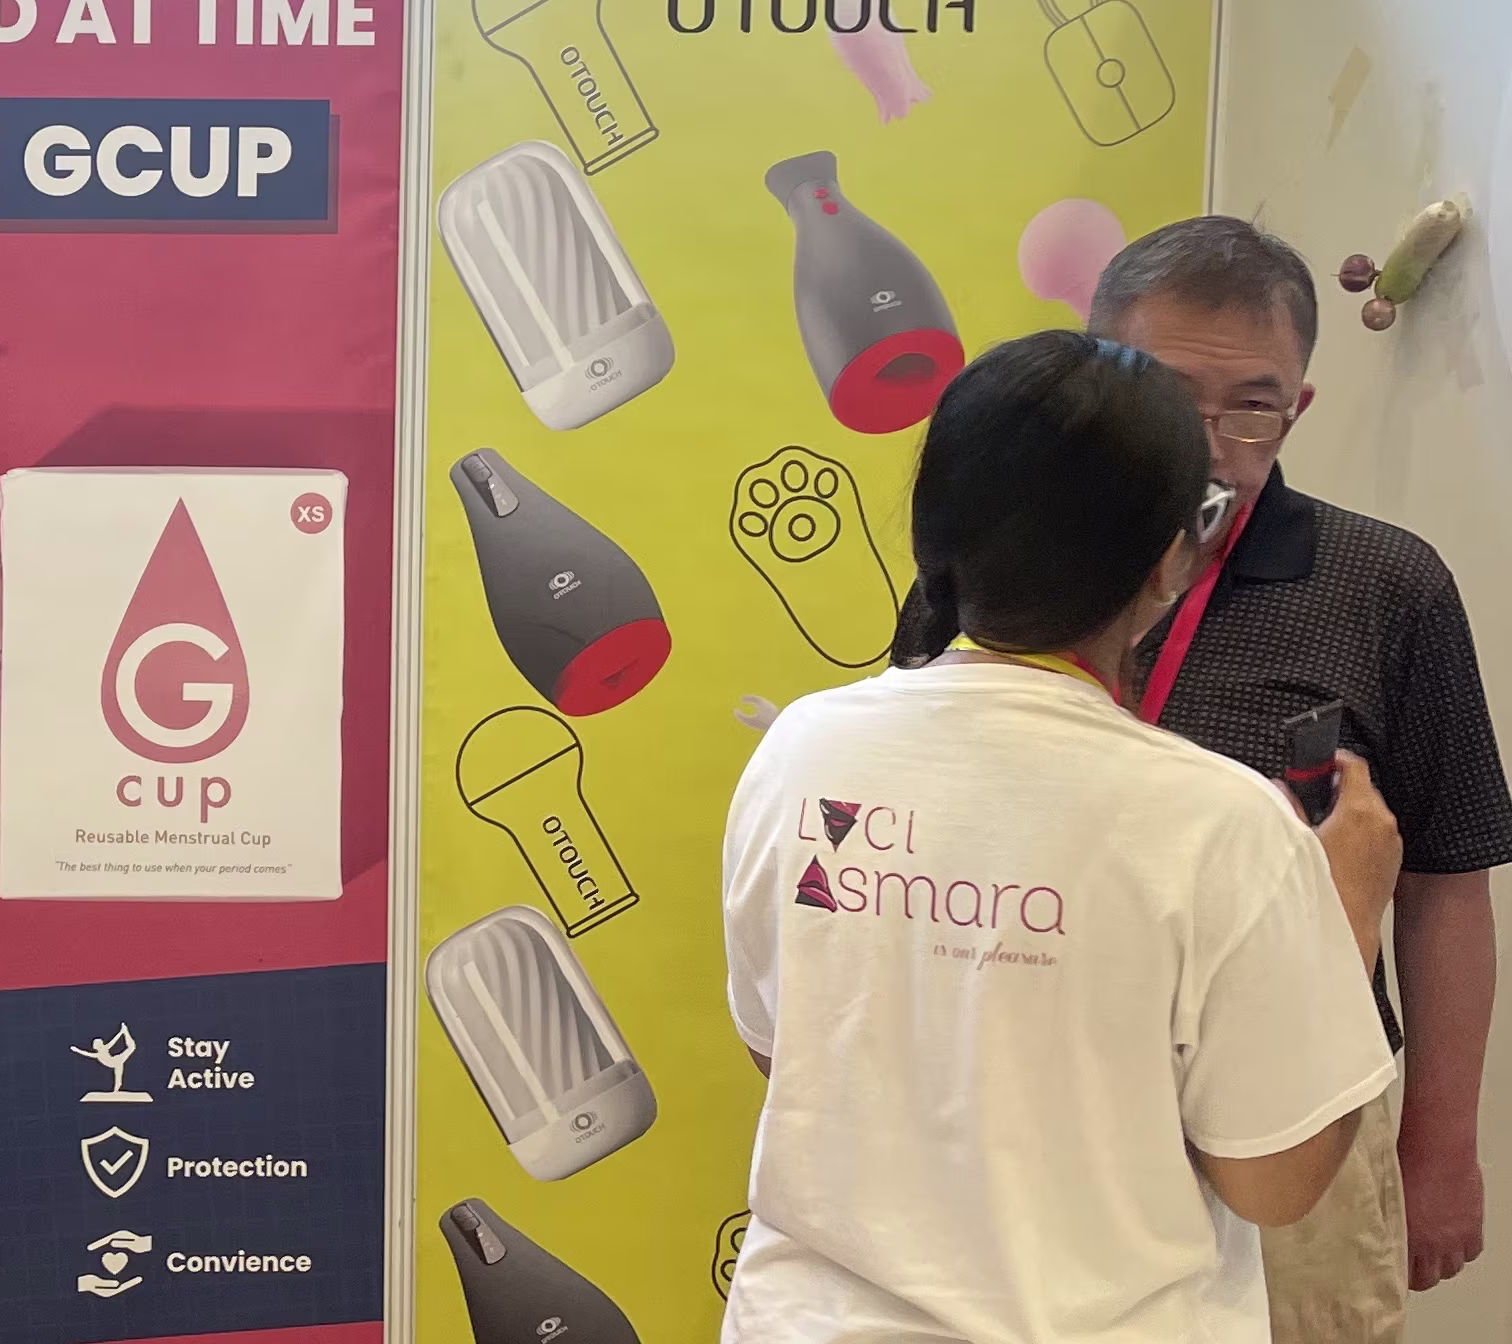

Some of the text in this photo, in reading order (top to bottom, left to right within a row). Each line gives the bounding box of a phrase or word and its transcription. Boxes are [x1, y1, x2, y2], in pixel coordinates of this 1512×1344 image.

[560, 45, 625, 146] OTOUCH
[23, 124, 292, 198] GCUP
[296, 504, 326, 524] XS
[115, 622, 235, 748] G
[116, 774, 232, 824] cup
[74, 828, 272, 849] Reusable Menstrual Cup
[79, 861, 102, 873] best
[103, 861, 130, 875] thing
[132, 862, 142, 874] to
[144, 864, 163, 873] use
[165, 862, 193, 874] when
[194, 864, 217, 876] your
[218, 862, 252, 876] period
[541, 815, 606, 911] OTOUCH
[168, 1036, 231, 1063] Stay
[167, 1068, 255, 1089] Active
[167, 1156, 308, 1178] Protection
[166, 1252, 312, 1273] Convience
